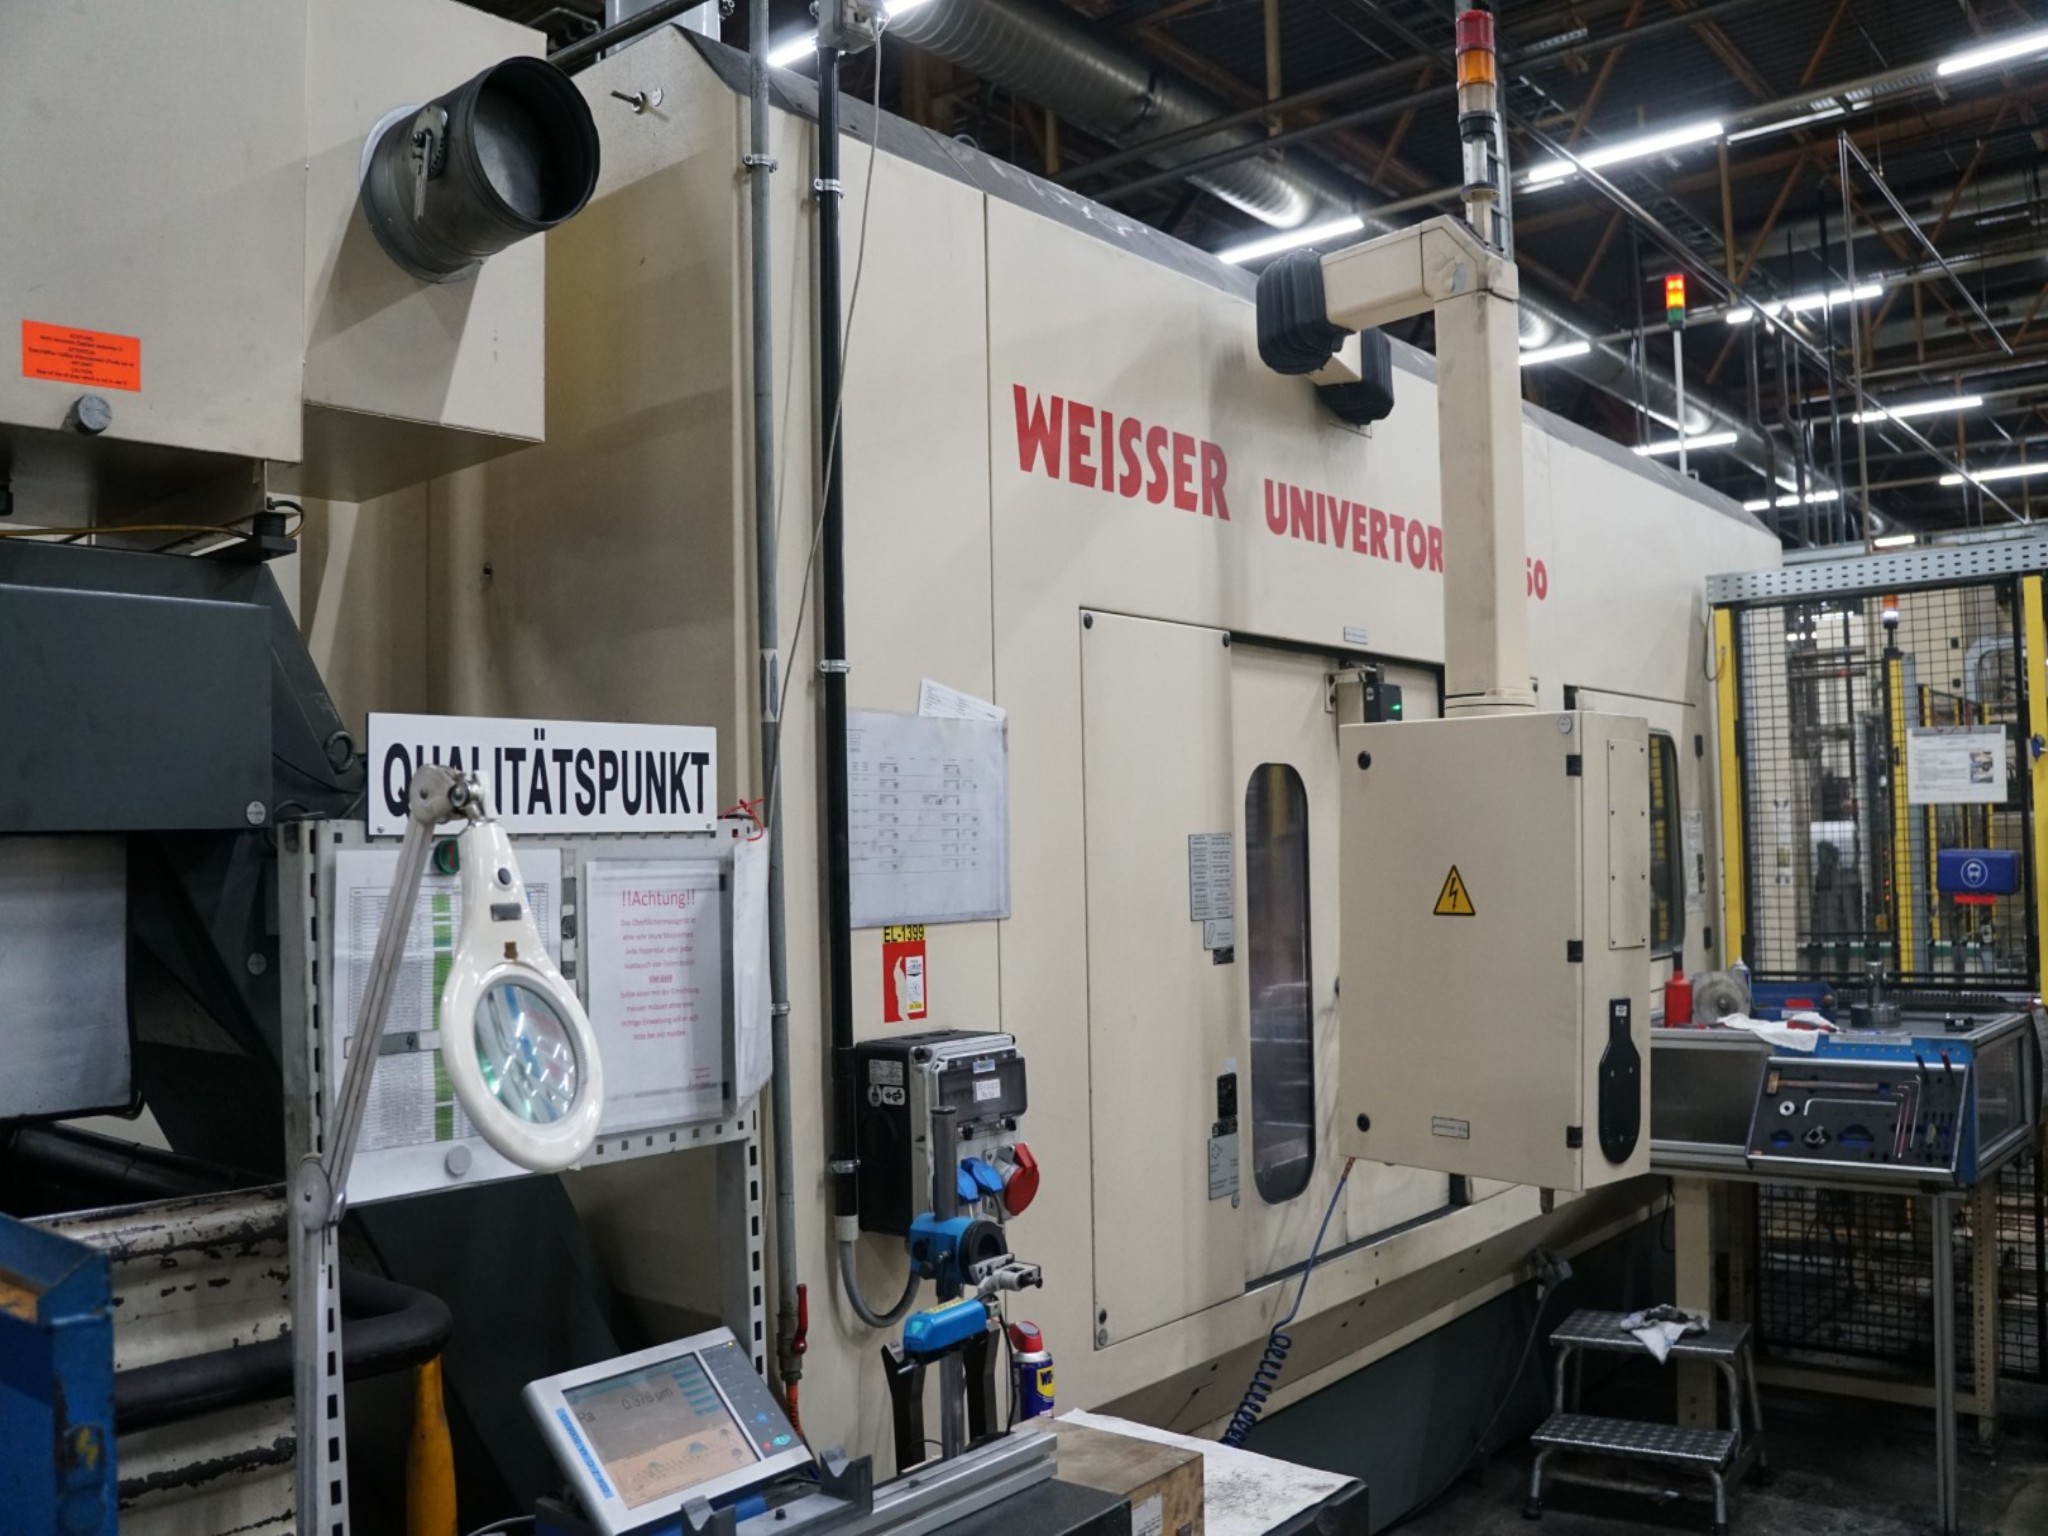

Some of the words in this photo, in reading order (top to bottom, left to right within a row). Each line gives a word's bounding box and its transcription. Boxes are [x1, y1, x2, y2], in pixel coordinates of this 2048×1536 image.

[1013, 383, 1230, 522] WEISSER
[1264, 478, 1444, 574] UNIVERTOR
[622, 888, 695, 909] !!Achtung!!
